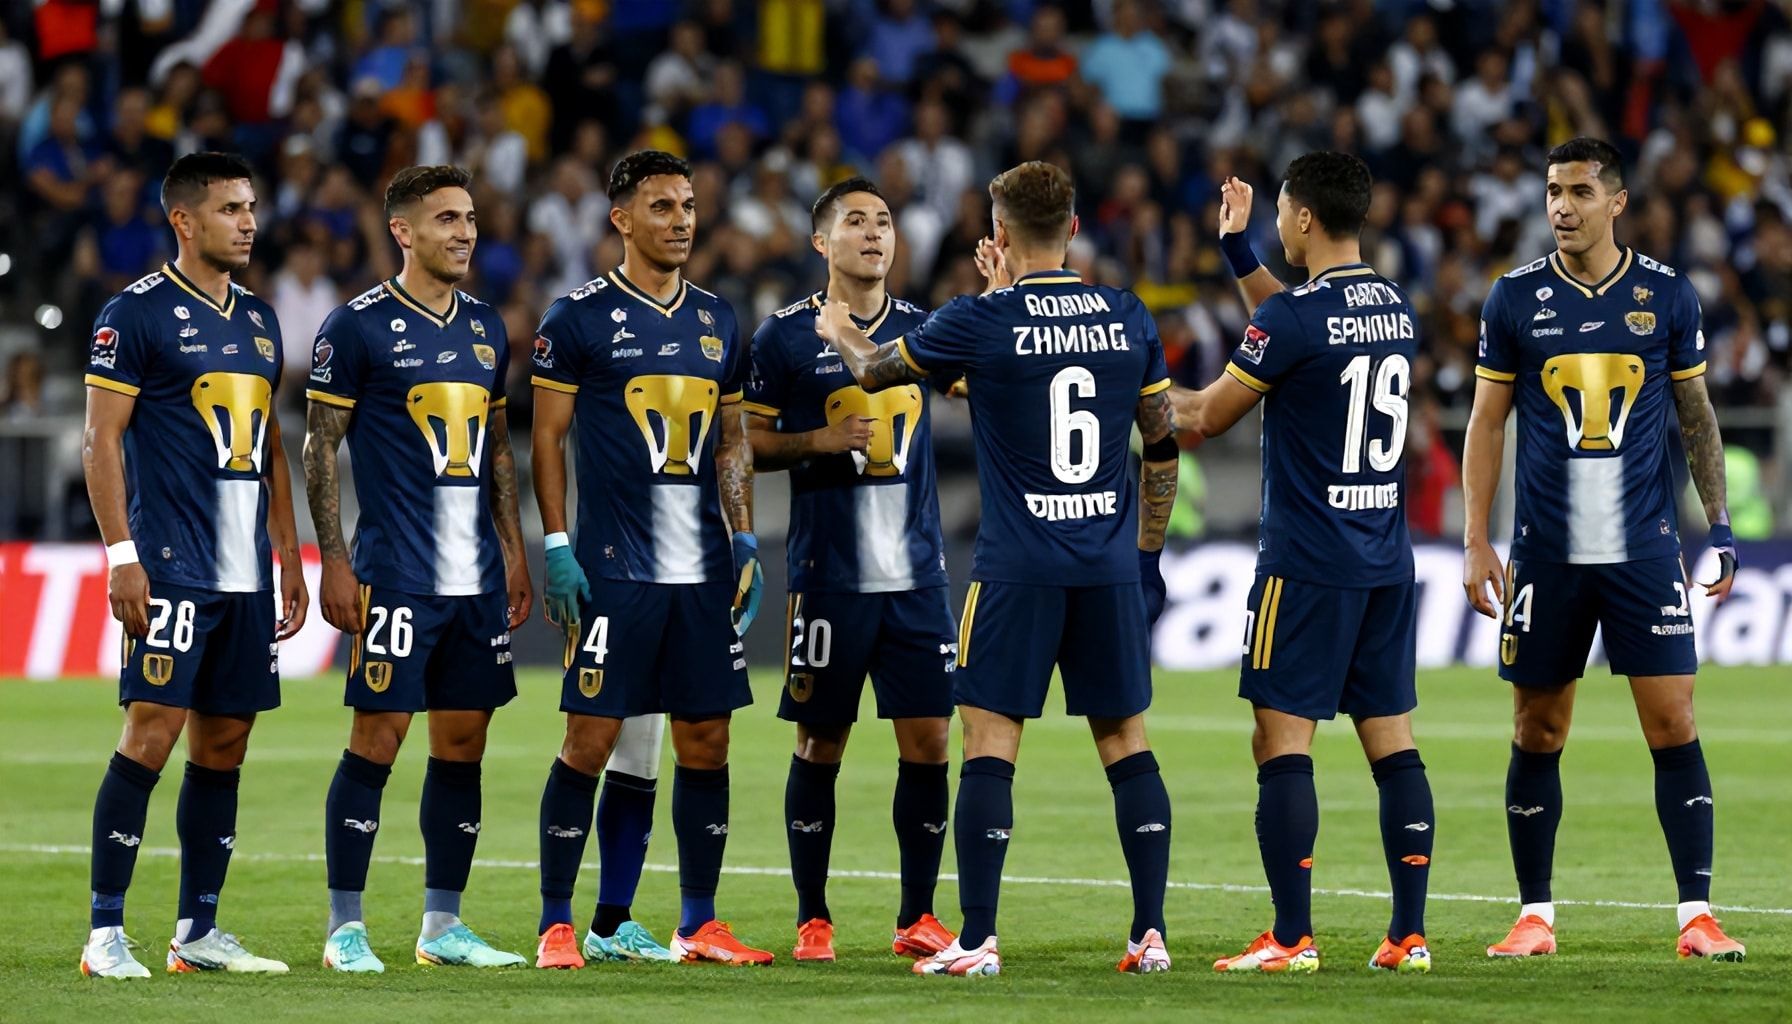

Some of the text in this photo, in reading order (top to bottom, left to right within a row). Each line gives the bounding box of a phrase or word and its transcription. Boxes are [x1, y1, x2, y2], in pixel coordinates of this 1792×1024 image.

[1050, 365, 1100, 484] 6
[146, 598, 195, 652] 28
[366, 606, 413, 657] 26
[583, 616, 609, 664] 4
[791, 616, 832, 668] 20
